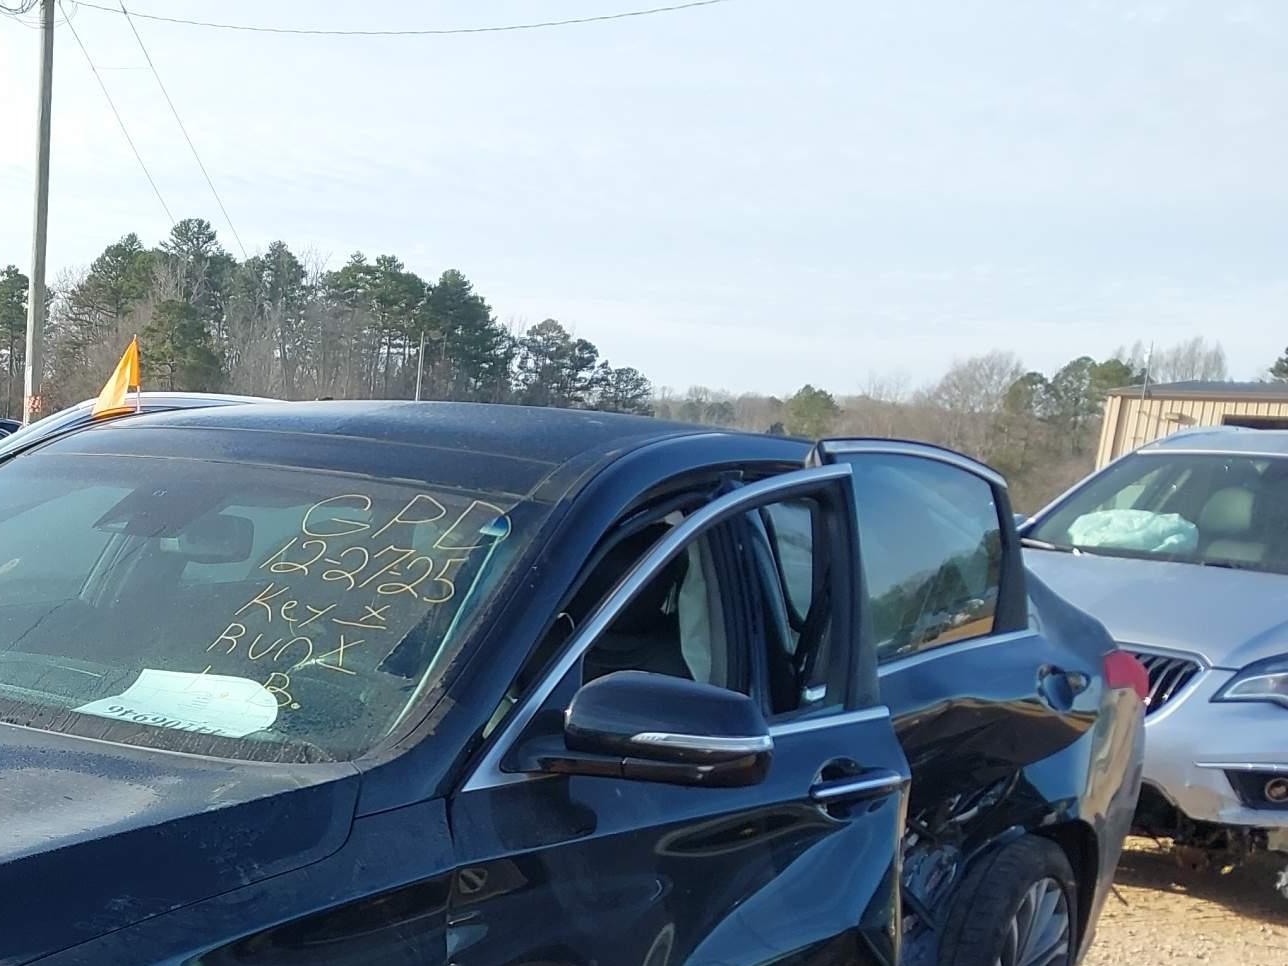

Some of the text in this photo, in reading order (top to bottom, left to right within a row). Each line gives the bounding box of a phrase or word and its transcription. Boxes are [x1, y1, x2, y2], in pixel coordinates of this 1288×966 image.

[302, 494, 511, 550] GPD
[258, 536, 469, 604] 12-27-25
[234, 582, 337, 628] Key
